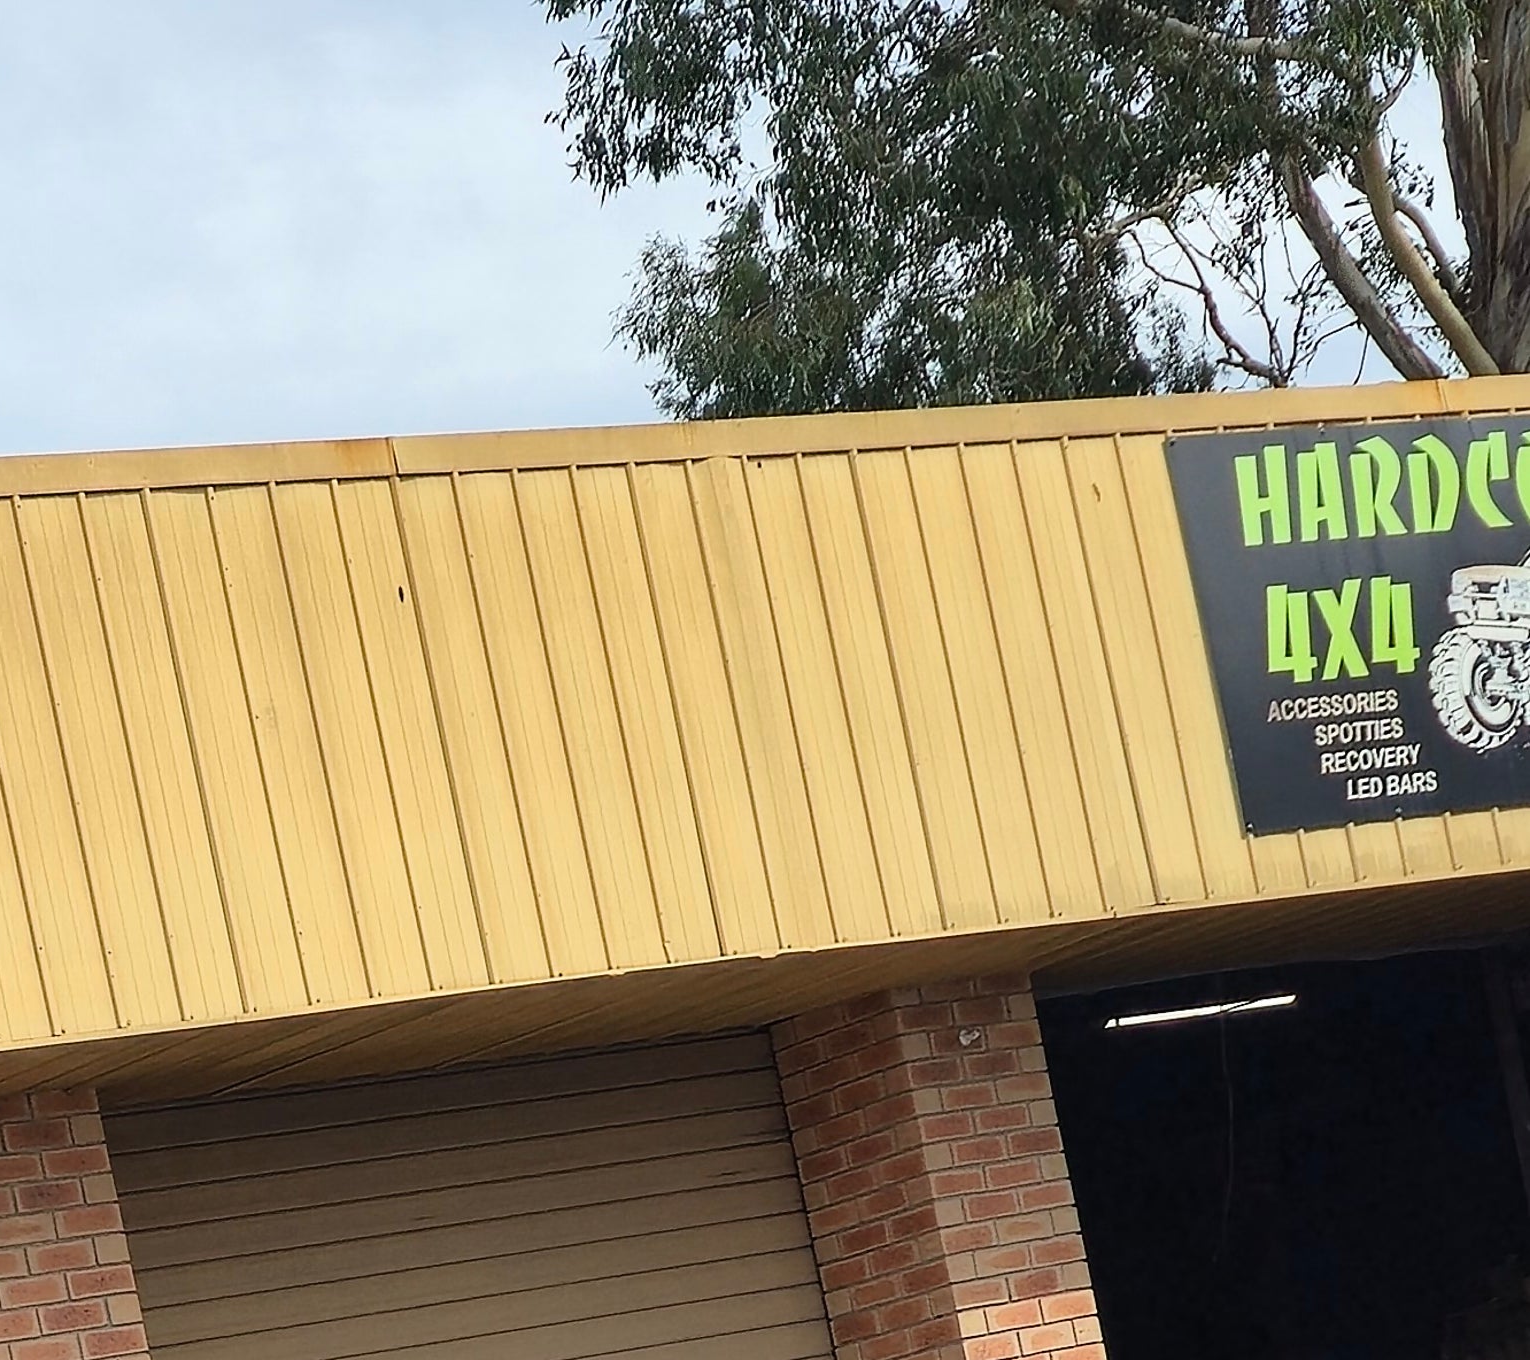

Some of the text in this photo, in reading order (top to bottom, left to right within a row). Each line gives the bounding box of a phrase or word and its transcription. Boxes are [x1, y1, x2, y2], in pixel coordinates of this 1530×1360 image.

[1267, 689, 1399, 723] ACCESSORIES
[1315, 717, 1405, 747] SPOTTIES
[1320, 743, 1421, 775] RECOVERY
[1347, 770, 1438, 801] LED BARS
